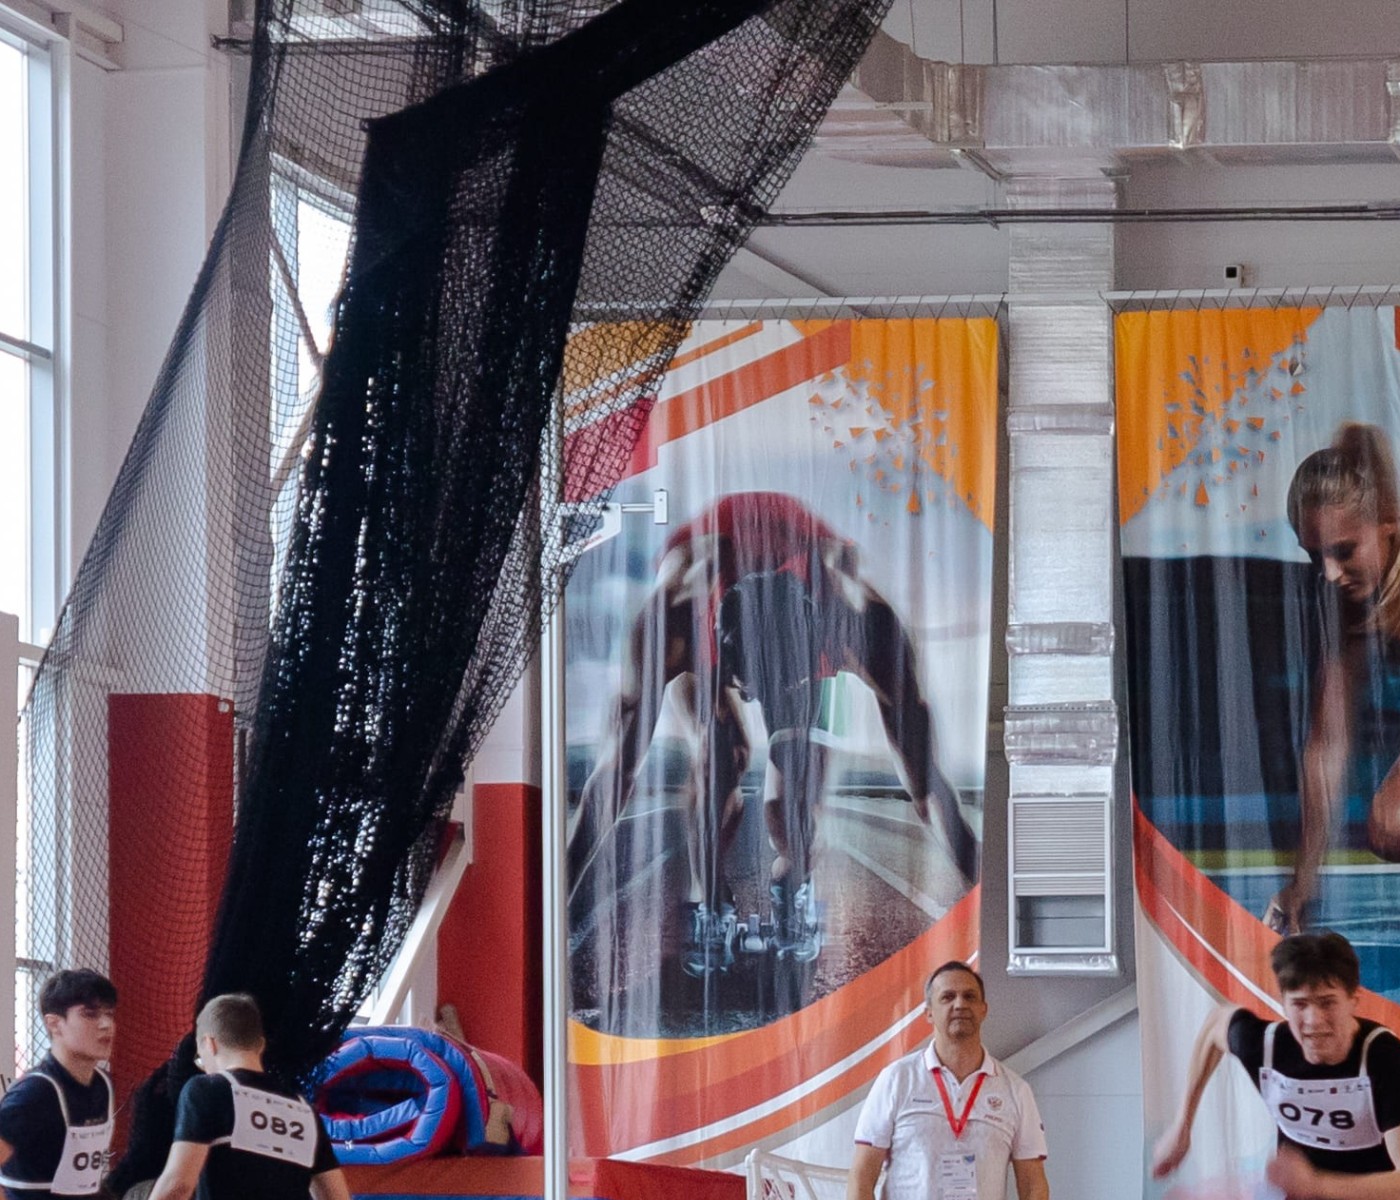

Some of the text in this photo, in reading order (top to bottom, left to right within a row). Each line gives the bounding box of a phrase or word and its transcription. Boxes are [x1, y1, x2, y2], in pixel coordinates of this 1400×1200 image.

[250, 1110, 305, 1141] 082
[1279, 1102, 1356, 1130] 078
[73, 1150, 109, 1171] 08
